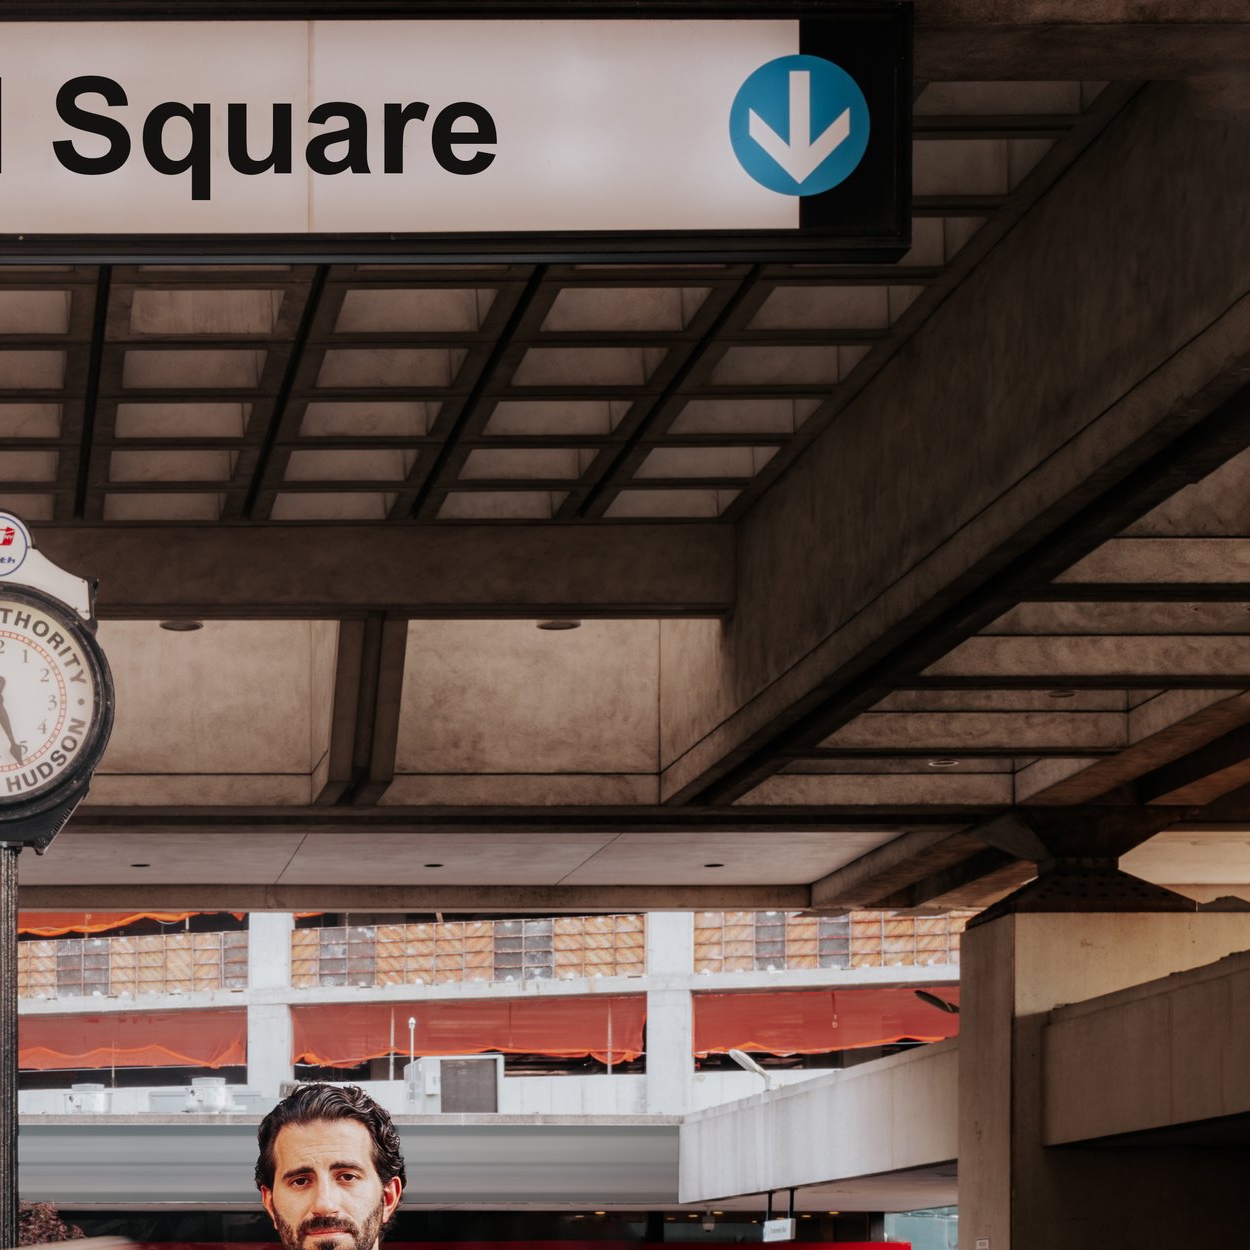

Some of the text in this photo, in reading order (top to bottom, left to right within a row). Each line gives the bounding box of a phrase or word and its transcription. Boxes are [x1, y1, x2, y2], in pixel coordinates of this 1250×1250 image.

[53, 76, 498, 200] Square
[22, 649, 29, 664] 1
[39, 668, 50, 682] 2
[47, 695, 57, 711] 3
[37, 718, 47, 734] 4
[6, 717, 86, 792] HUDSON
